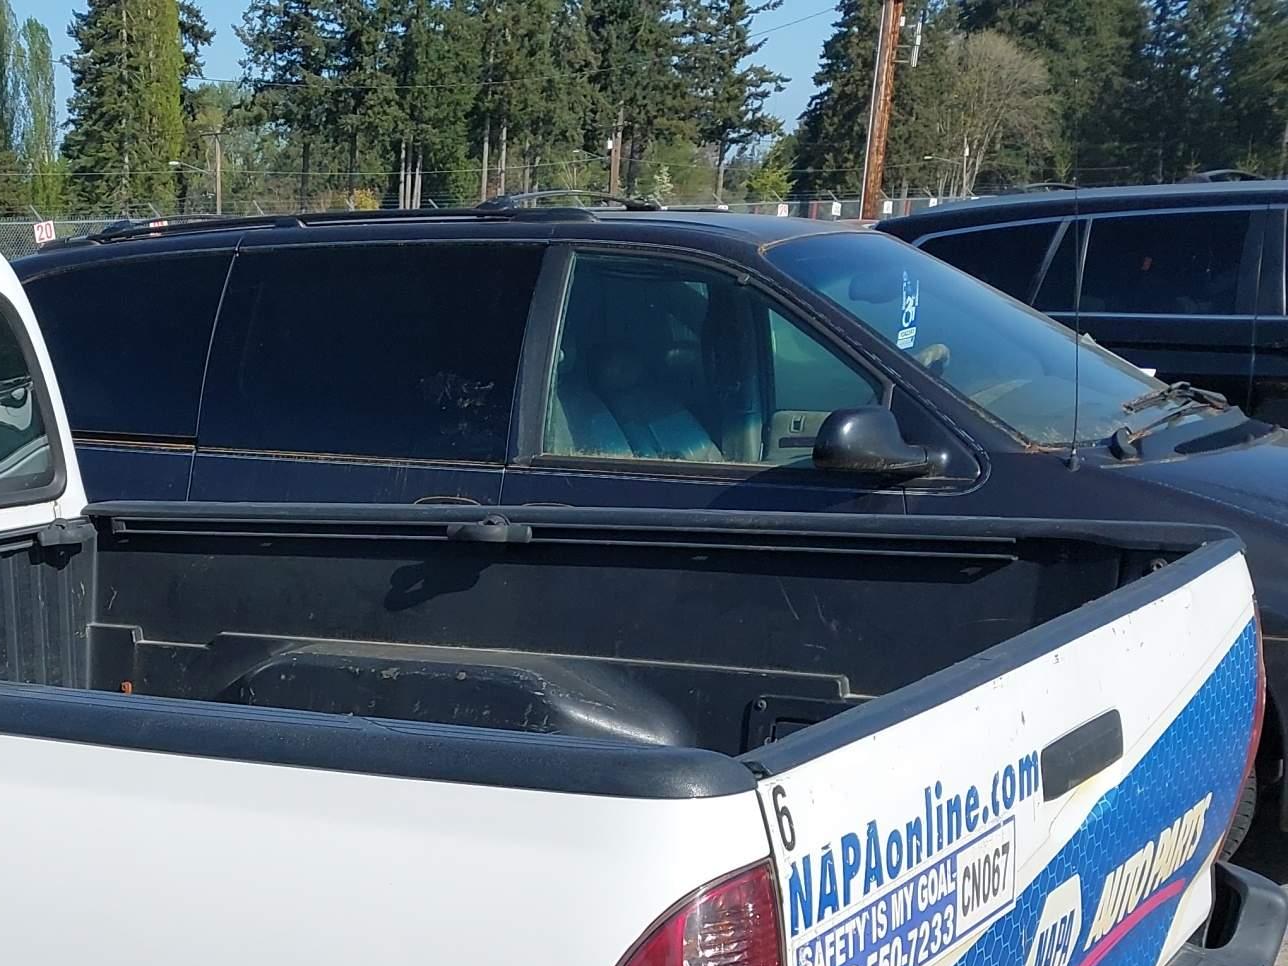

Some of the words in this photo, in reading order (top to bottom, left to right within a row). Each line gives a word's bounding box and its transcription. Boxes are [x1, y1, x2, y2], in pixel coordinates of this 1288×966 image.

[36, 222, 54, 241] 20
[771, 785, 796, 851] 6
[788, 750, 1040, 937] NAPAonline.com
[871, 899, 888, 944] IS
[891, 881, 915, 932] MY
[917, 857, 957, 912] GOAL
[961, 841, 1010, 917] CN067
[1083, 840, 1155, 952] AUTO
[1143, 791, 1213, 900] PARTS
